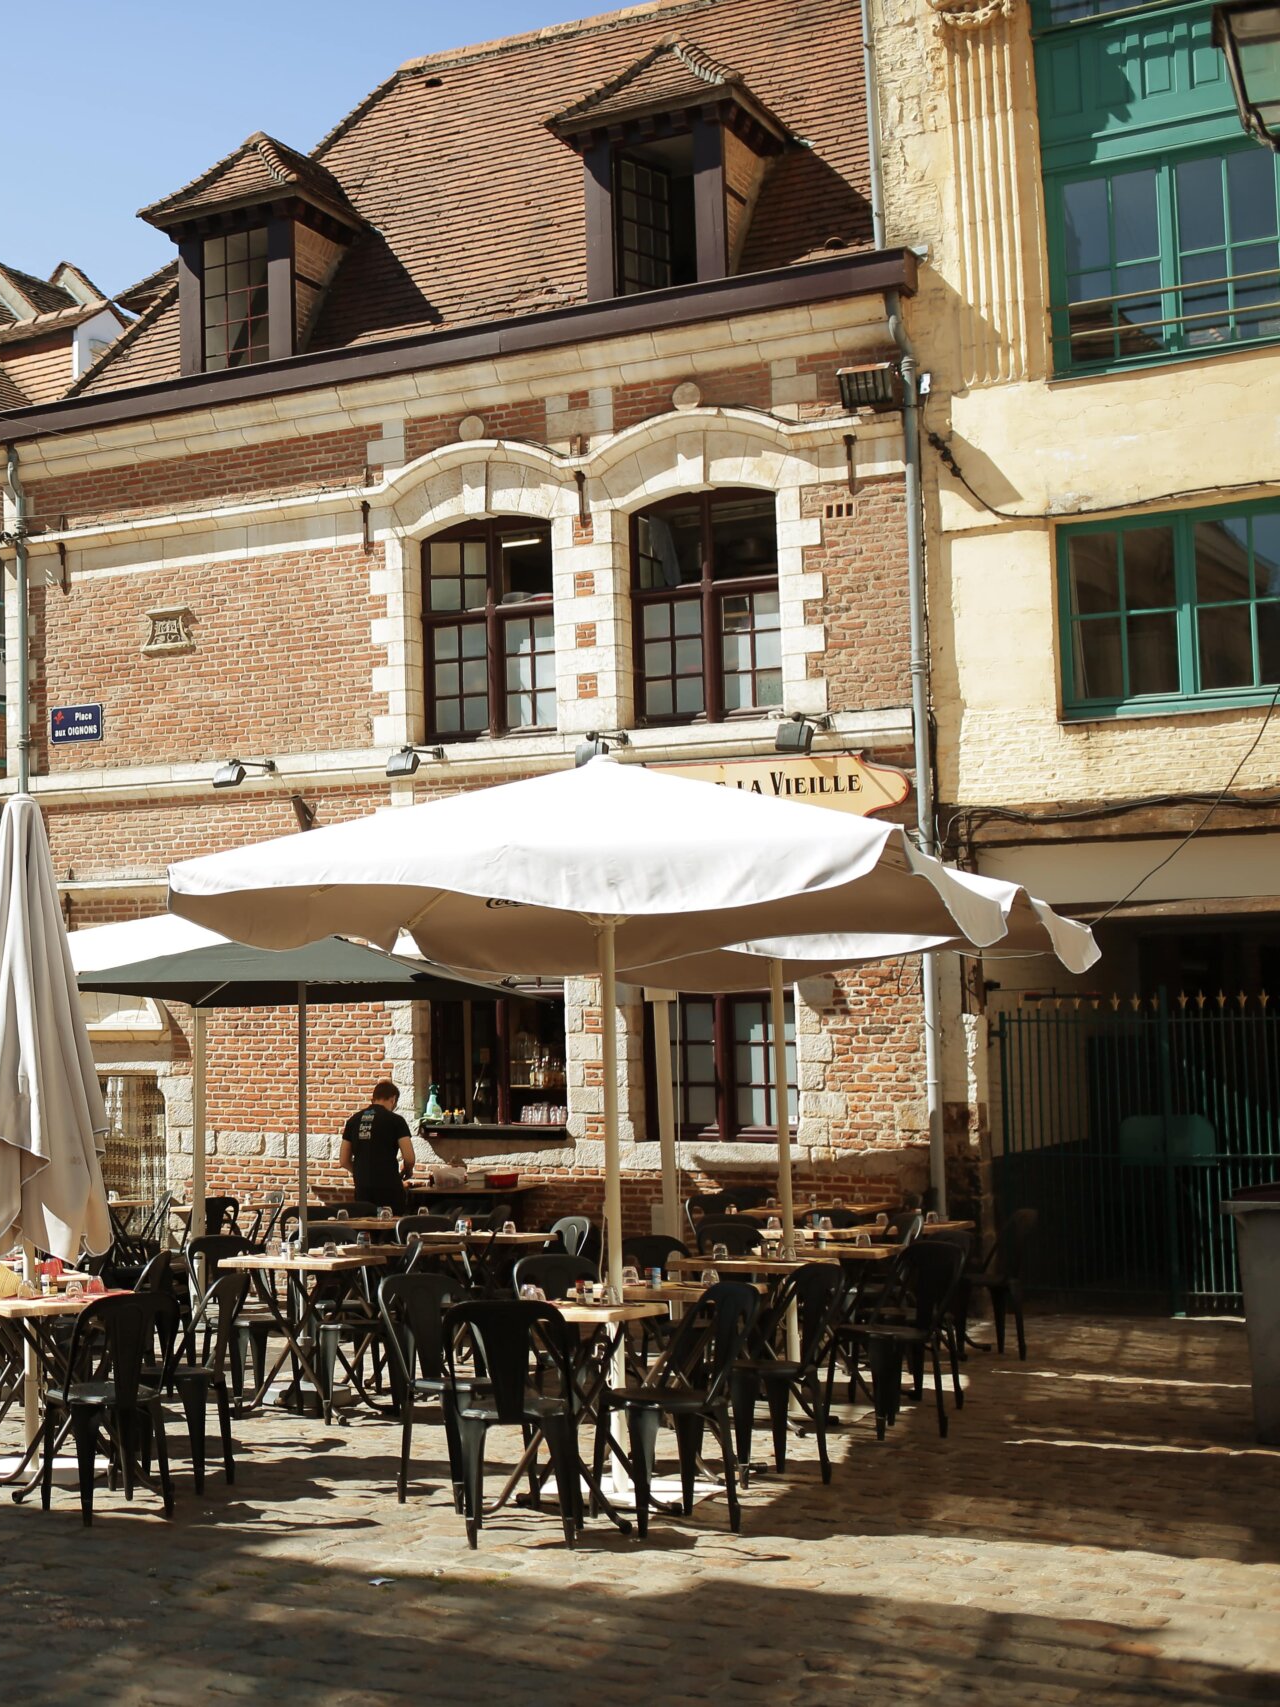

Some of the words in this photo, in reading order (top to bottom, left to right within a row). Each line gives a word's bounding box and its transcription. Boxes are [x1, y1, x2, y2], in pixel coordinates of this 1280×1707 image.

[75, 712, 92, 721] Place
[67, 725, 97, 736] OIGNONS
[770, 771, 862, 796] VIEILLE
